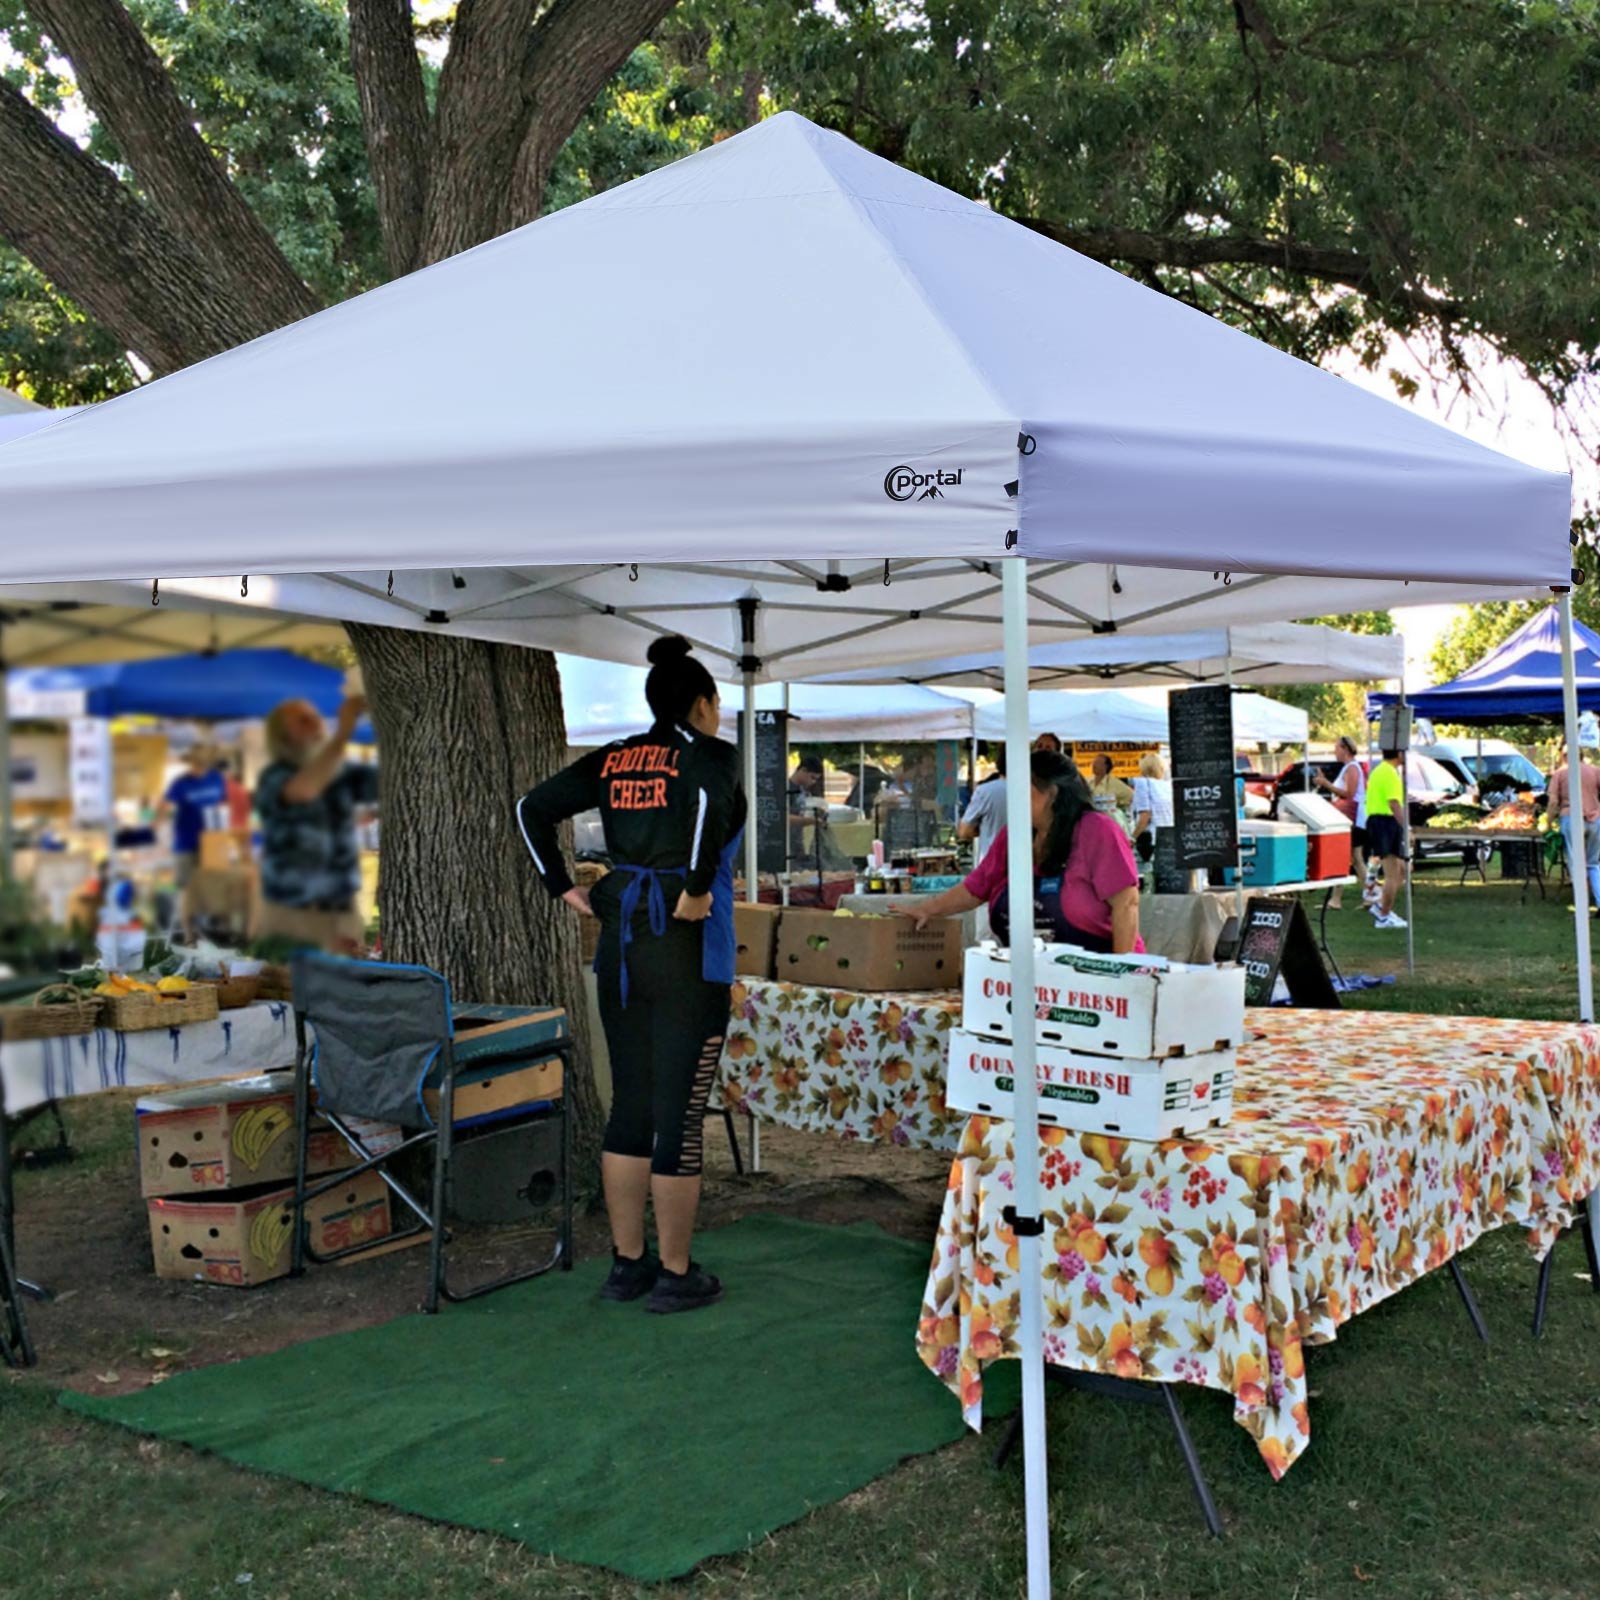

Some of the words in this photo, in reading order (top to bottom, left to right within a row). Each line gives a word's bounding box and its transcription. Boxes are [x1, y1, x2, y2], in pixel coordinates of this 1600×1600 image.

[896, 468, 963, 492] portal
[755, 712, 775, 725] EA
[600, 745, 680, 778] FOOTHILL
[610, 778, 667, 809] CHEER
[1183, 785, 1221, 801] KIDS
[1251, 911, 1282, 928] ICED
[983, 977, 1060, 1003] COURY
[1068, 990, 1129, 1019] FRESH
[1051, 1008, 1096, 1025] Vegetables
[969, 1052, 1055, 1081] COUNY
[1063, 1067, 1132, 1095] FRESH
